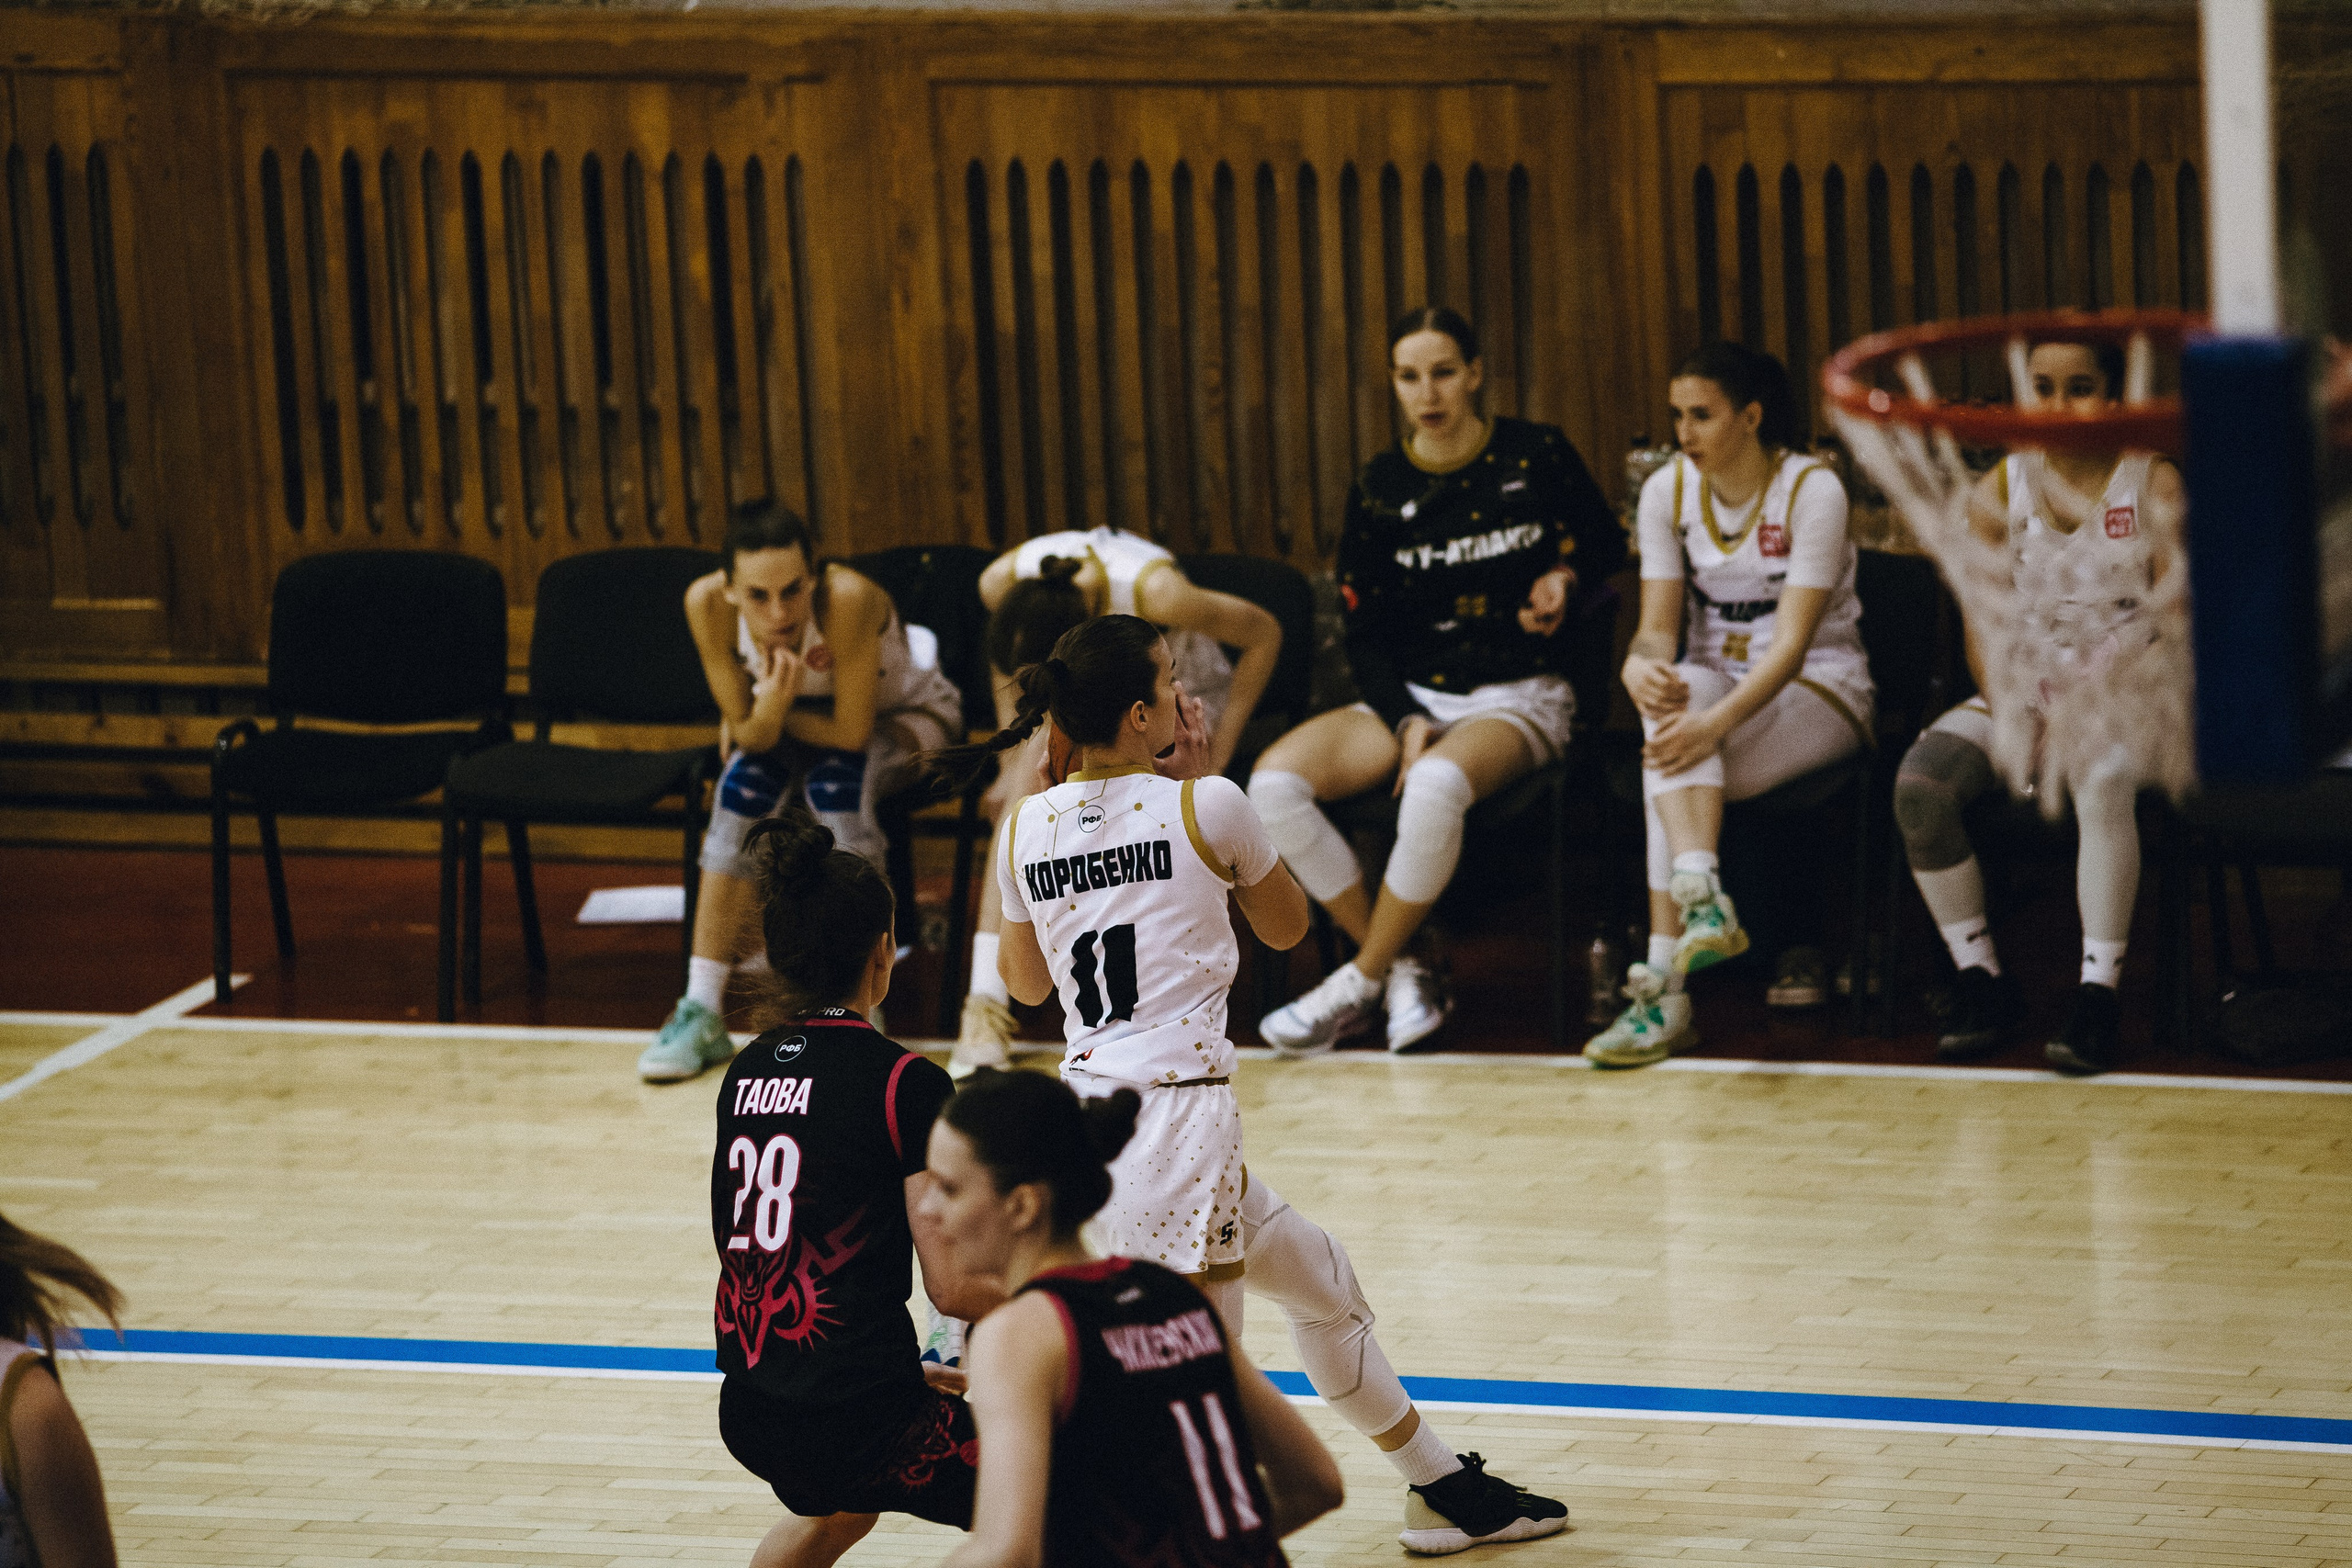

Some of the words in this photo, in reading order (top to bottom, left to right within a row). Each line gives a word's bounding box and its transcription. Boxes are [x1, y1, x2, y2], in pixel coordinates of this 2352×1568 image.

[1081, 814, 1102, 825] РФБ
[1024, 840, 1172, 903] КОРОБЕНКО
[1069, 923, 1139, 1028] 11
[779, 1043, 802, 1053] РФБ
[727, 1134, 802, 1252] 28
